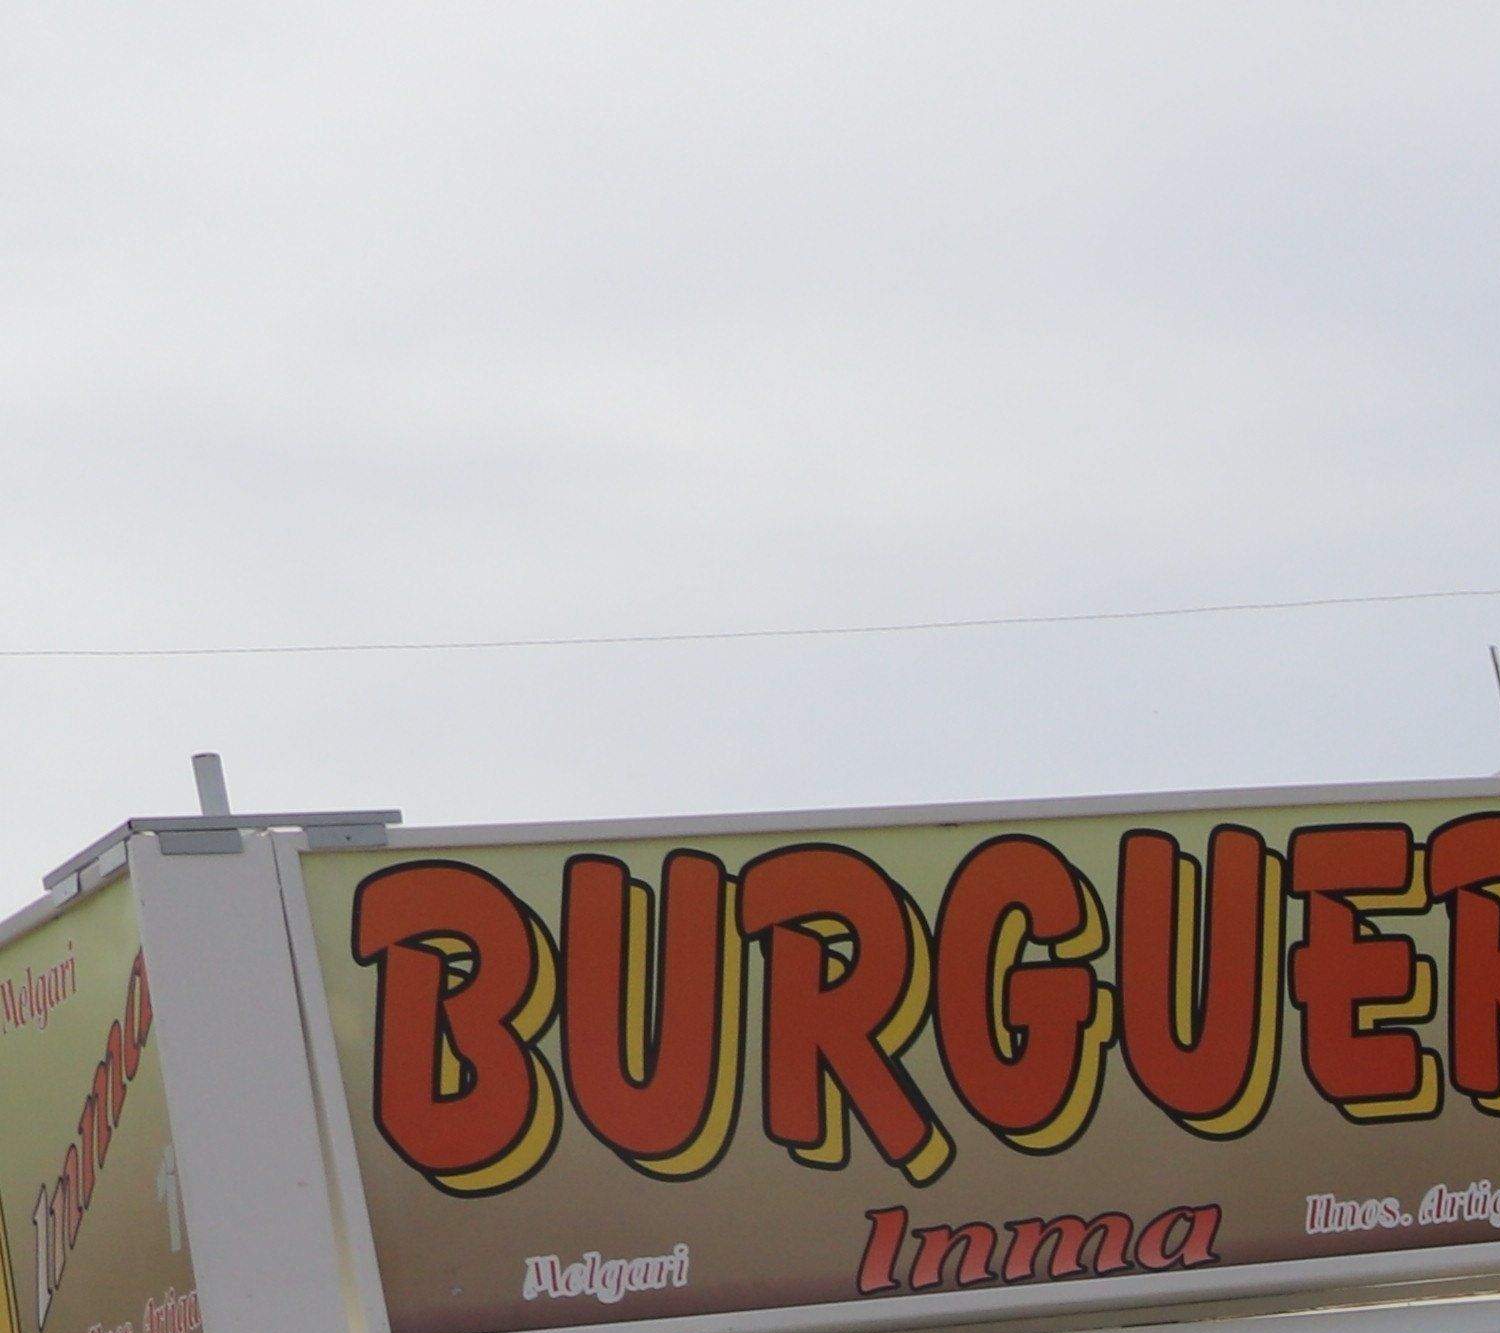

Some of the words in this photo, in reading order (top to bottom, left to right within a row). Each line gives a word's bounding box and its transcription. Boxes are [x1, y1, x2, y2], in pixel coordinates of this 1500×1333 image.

[1305, 1193, 1414, 1234] Hnos.
[523, 1243, 690, 1303] Melgari
[856, 1203, 1222, 1296] Inma
